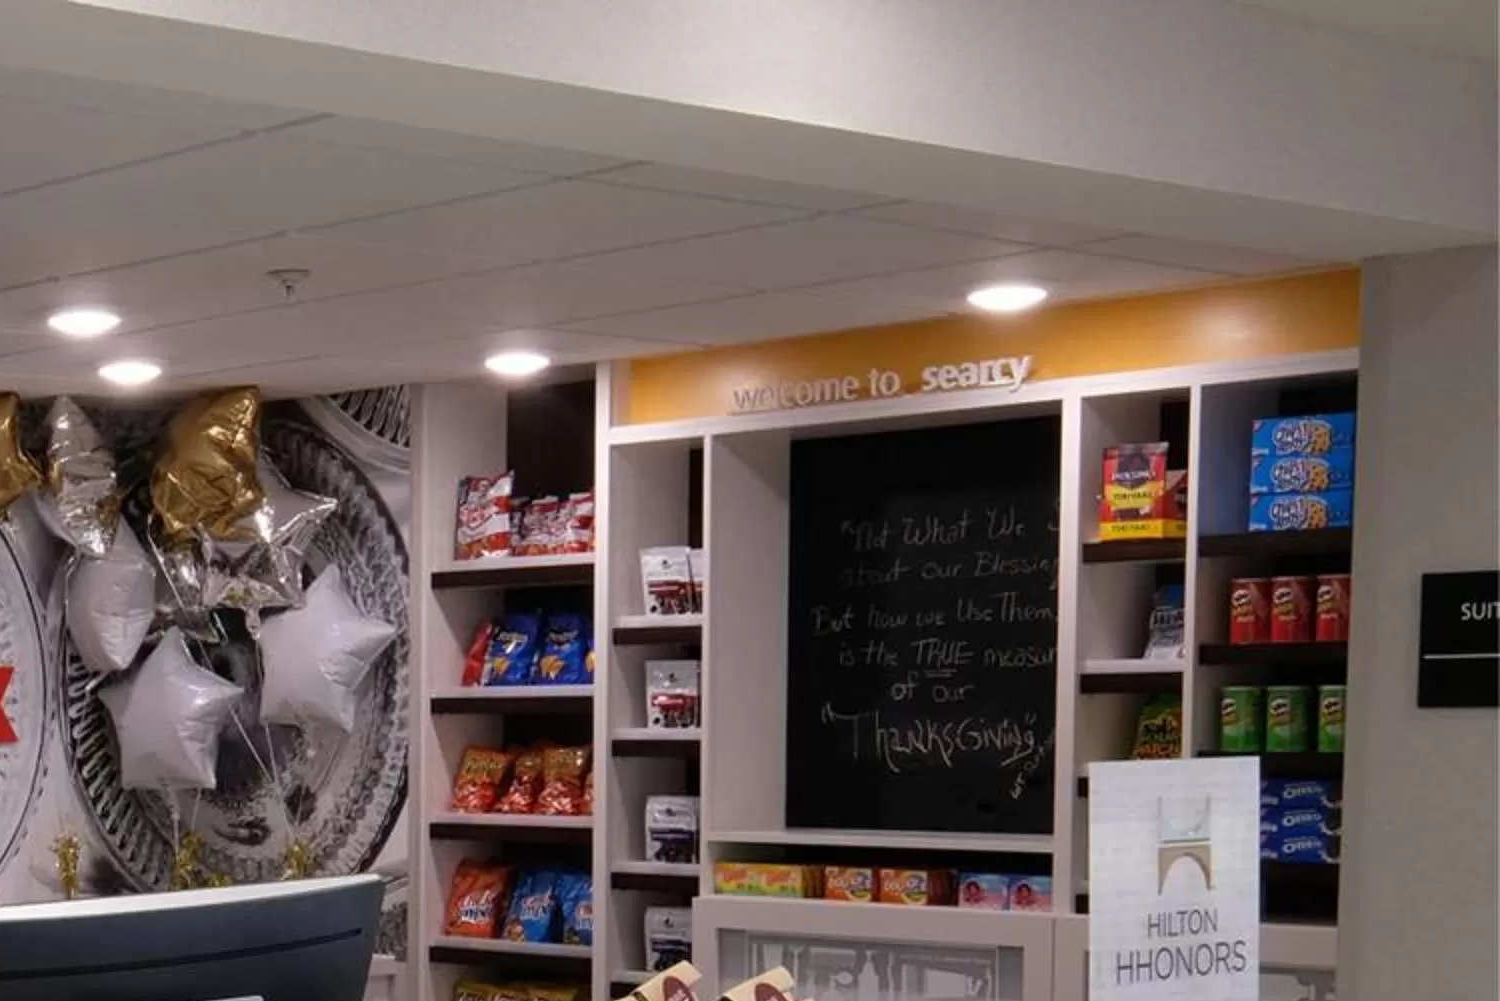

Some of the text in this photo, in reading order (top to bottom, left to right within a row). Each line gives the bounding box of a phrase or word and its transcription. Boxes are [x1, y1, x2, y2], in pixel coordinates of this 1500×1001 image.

[731, 354, 1032, 411] welcome to searcy
[811, 605, 857, 635] But
[915, 609, 948, 629] we
[838, 642, 857, 668] is
[860, 640, 901, 668] the
[911, 636, 977, 668] TRUE
[889, 671, 978, 704] of our
[1146, 908, 1218, 940] HILTON
[1115, 940, 1247, 986] HHONORS
